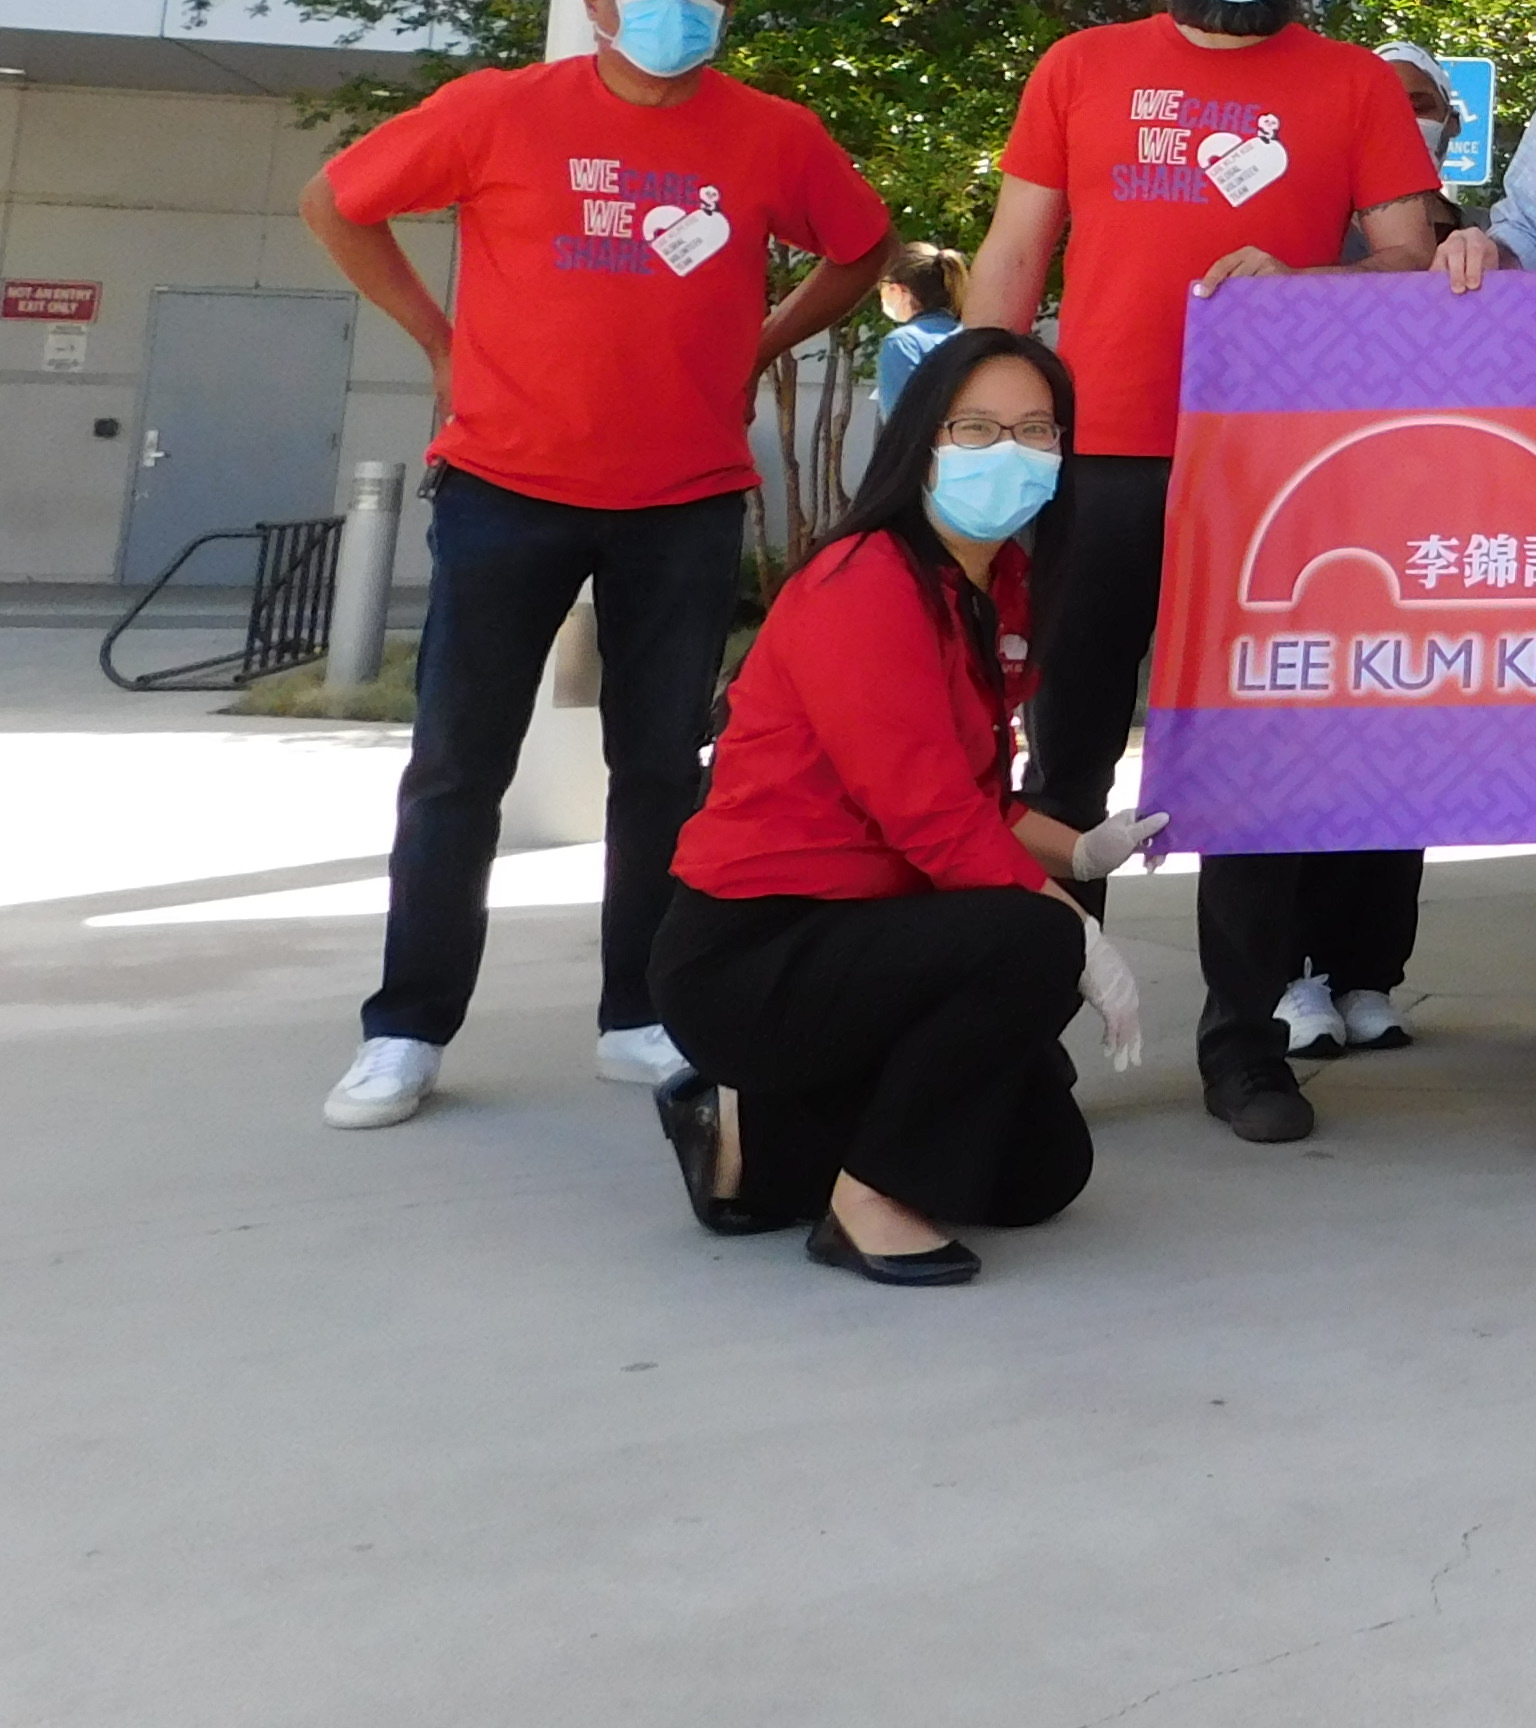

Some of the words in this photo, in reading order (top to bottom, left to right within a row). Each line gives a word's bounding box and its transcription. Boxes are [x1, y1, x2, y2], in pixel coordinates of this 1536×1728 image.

[1130, 89, 1184, 121] WE
[1177, 97, 1262, 135] CARE
[1138, 127, 1192, 165] WE
[569, 158, 621, 193] WE
[619, 168, 701, 206] CARE
[1112, 164, 1209, 204] SHARE
[583, 199, 636, 238] WE
[554, 235, 654, 275] SHARE
[1237, 640, 1331, 691] LEE
[1352, 639, 1474, 691] KUM
